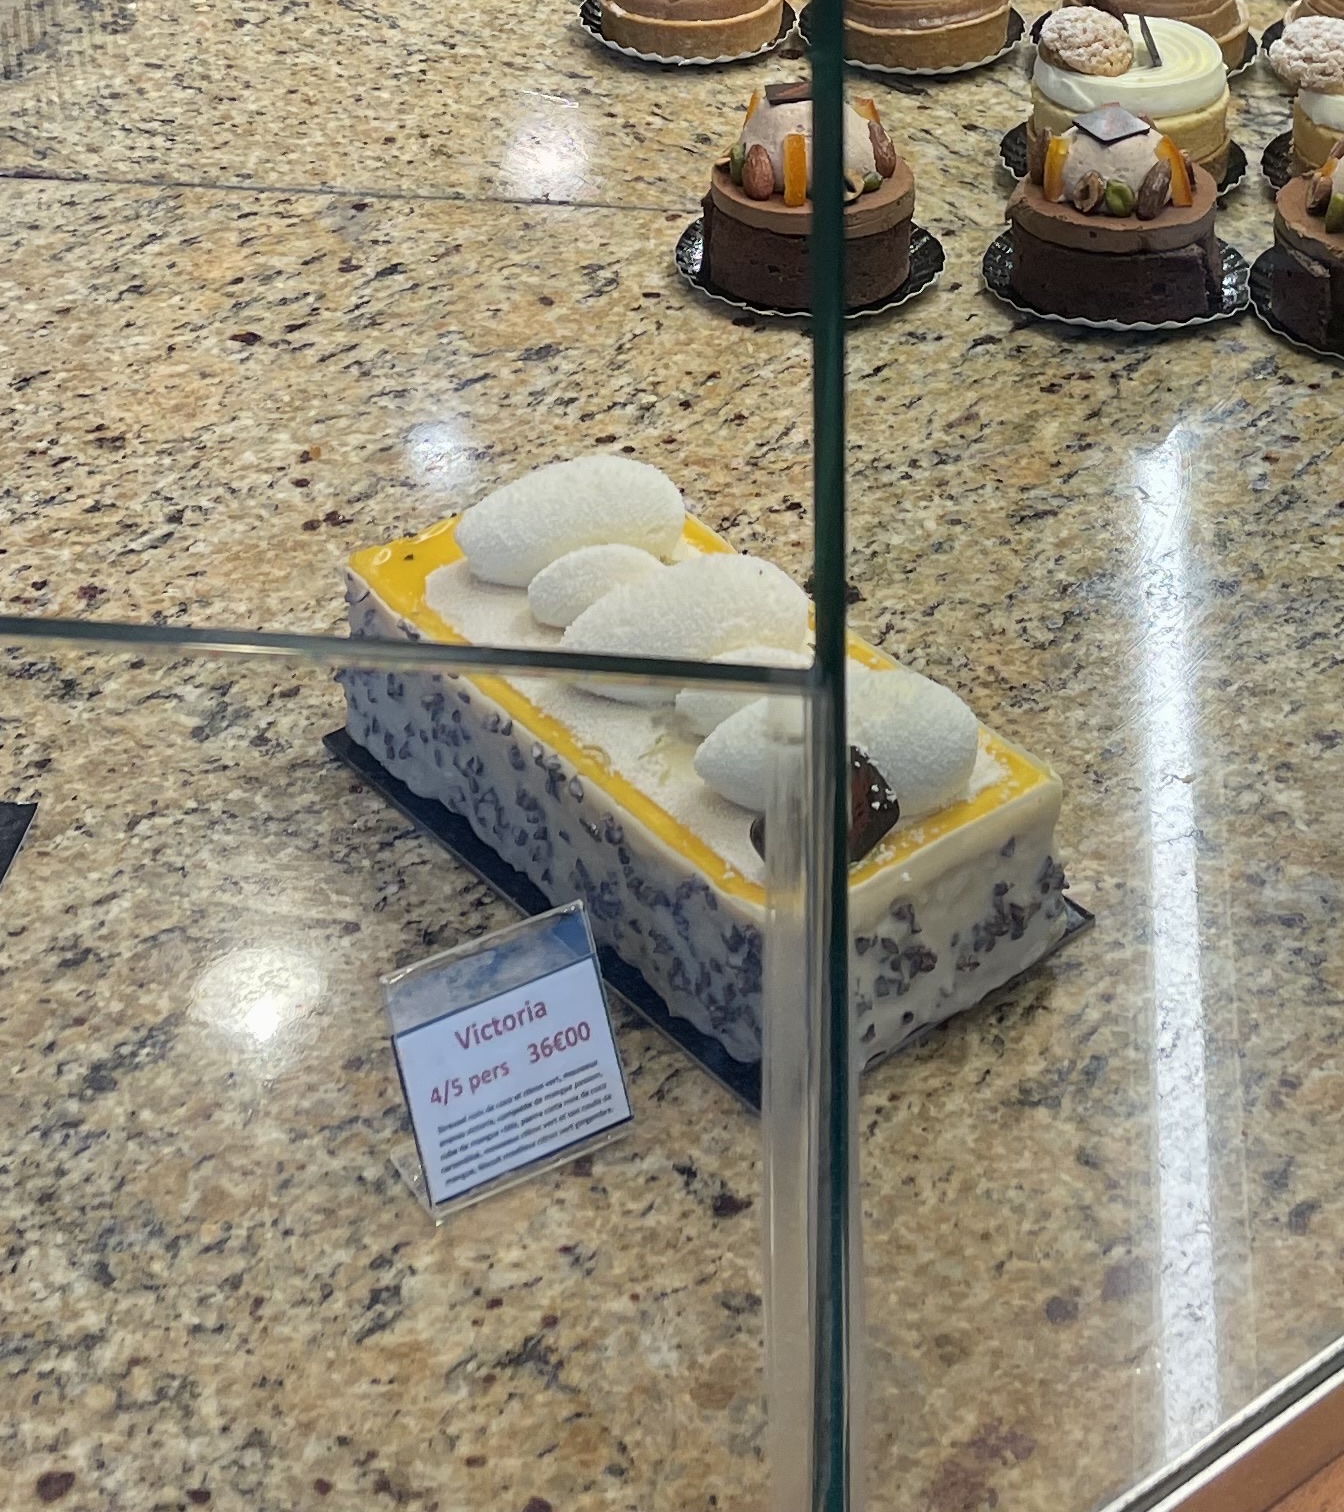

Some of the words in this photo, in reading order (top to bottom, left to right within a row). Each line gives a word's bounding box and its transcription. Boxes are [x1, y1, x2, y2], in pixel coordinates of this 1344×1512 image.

[454, 999, 548, 1050] Victoria
[430, 1077, 464, 1106] 4/5
[469, 1061, 511, 1095] pers
[526, 1021, 591, 1065] 36€00
